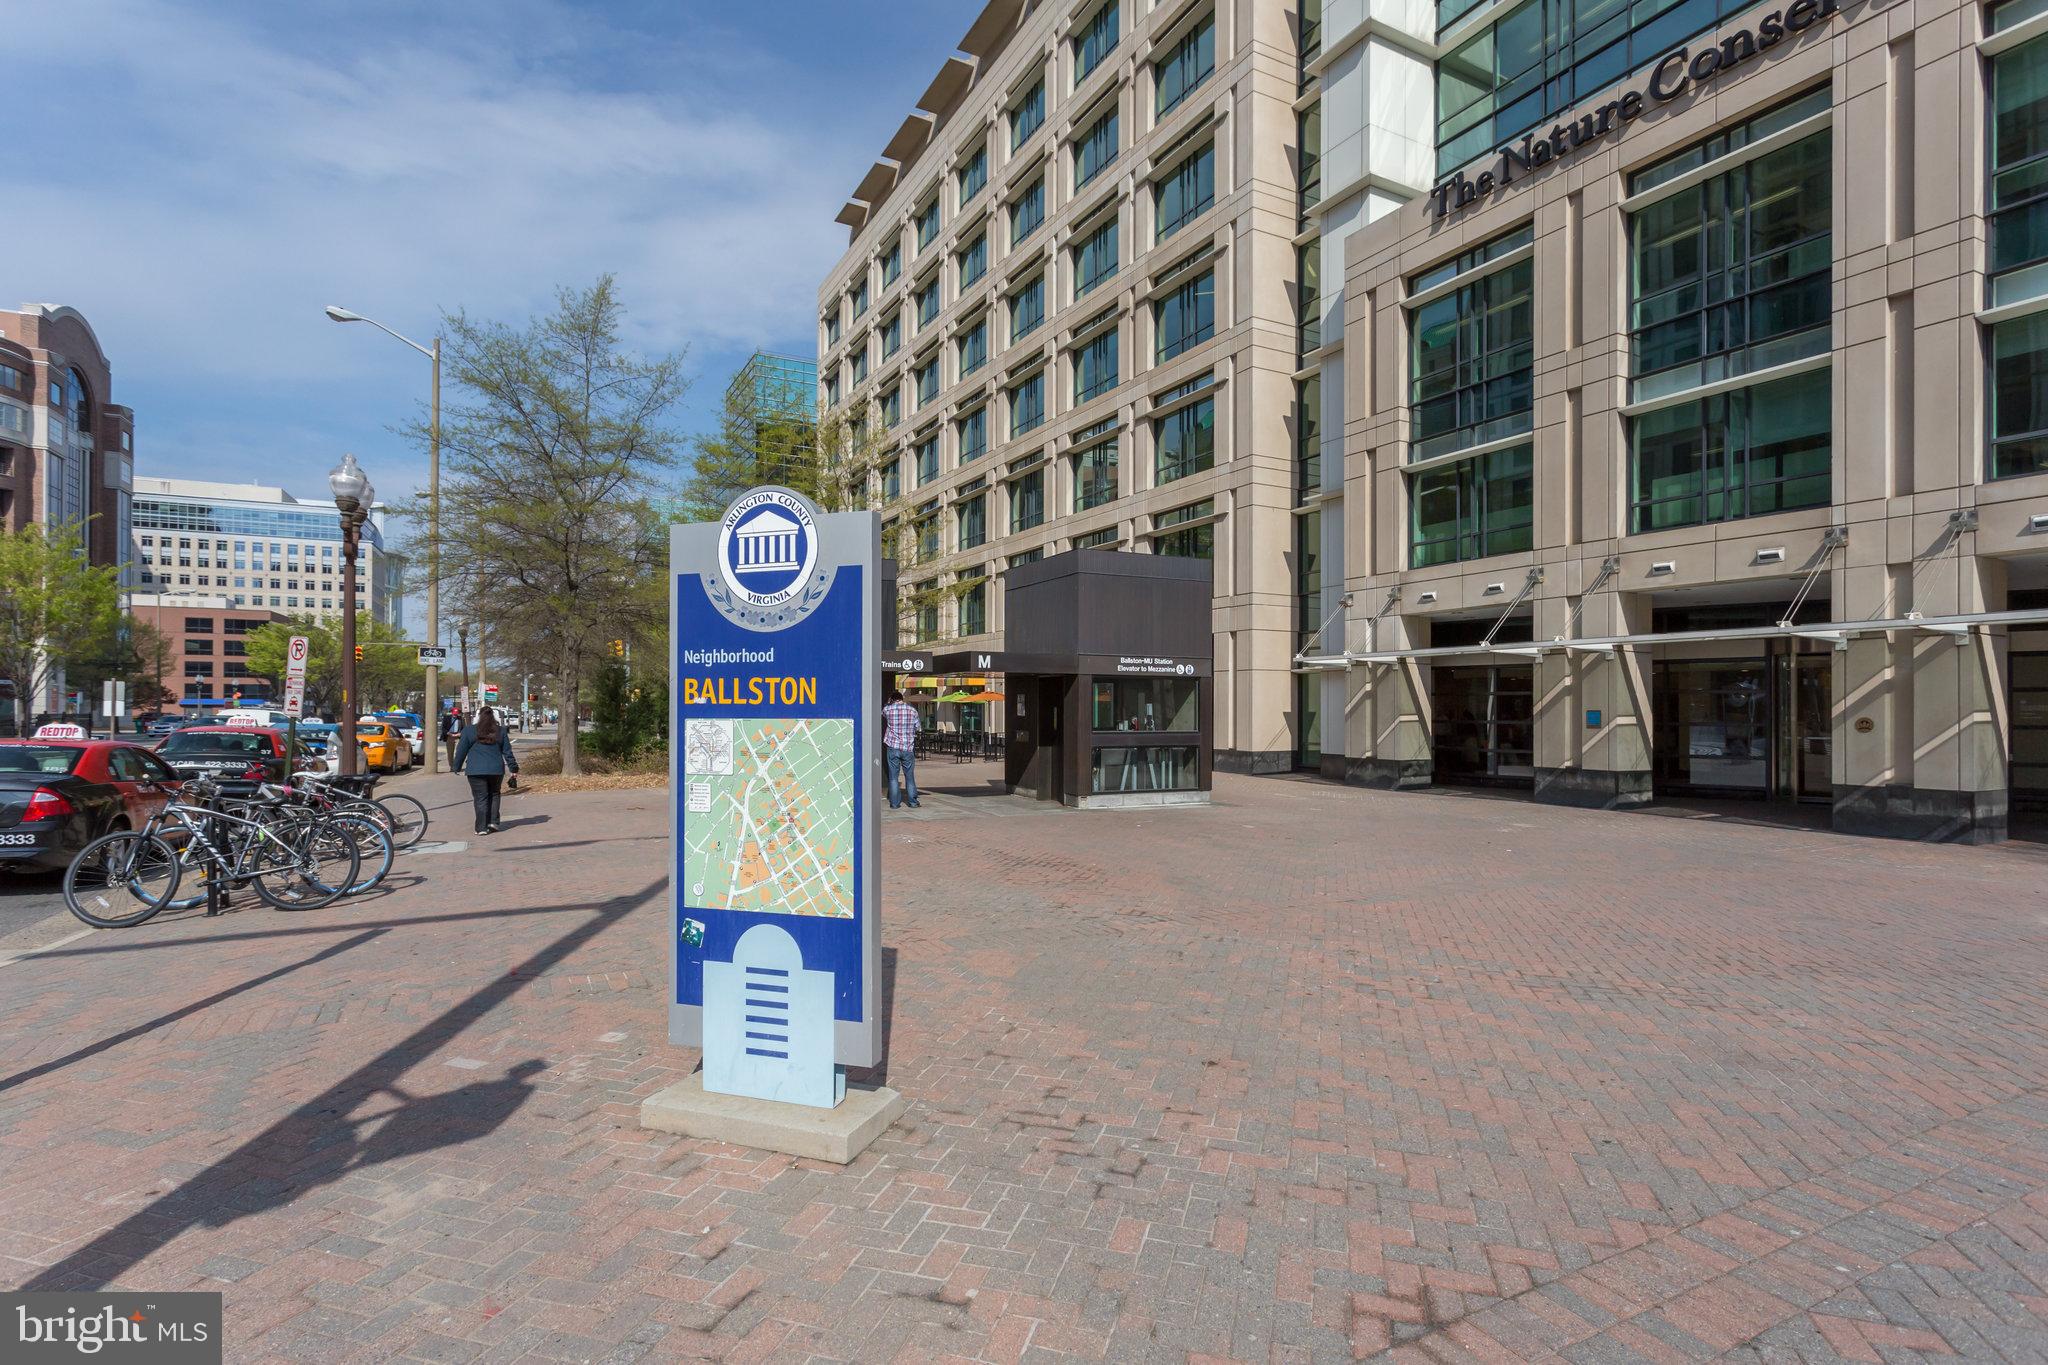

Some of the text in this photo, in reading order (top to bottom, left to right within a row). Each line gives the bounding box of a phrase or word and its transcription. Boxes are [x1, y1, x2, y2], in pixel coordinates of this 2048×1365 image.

[1431, 170, 1495, 218] The
[1498, 90, 1643, 186] Nature
[725, 493, 813, 531] ARLINGTON COUNTY
[747, 590, 791, 605] VIRGINIA
[684, 647, 774, 667] Neighborhood
[881, 660, 902, 668] Trains
[978, 654, 991, 669] M
[684, 677, 817, 705] BALLSTON
[40, 727, 79, 737] REDTOP
[205, 760, 247, 769] 522-3333
